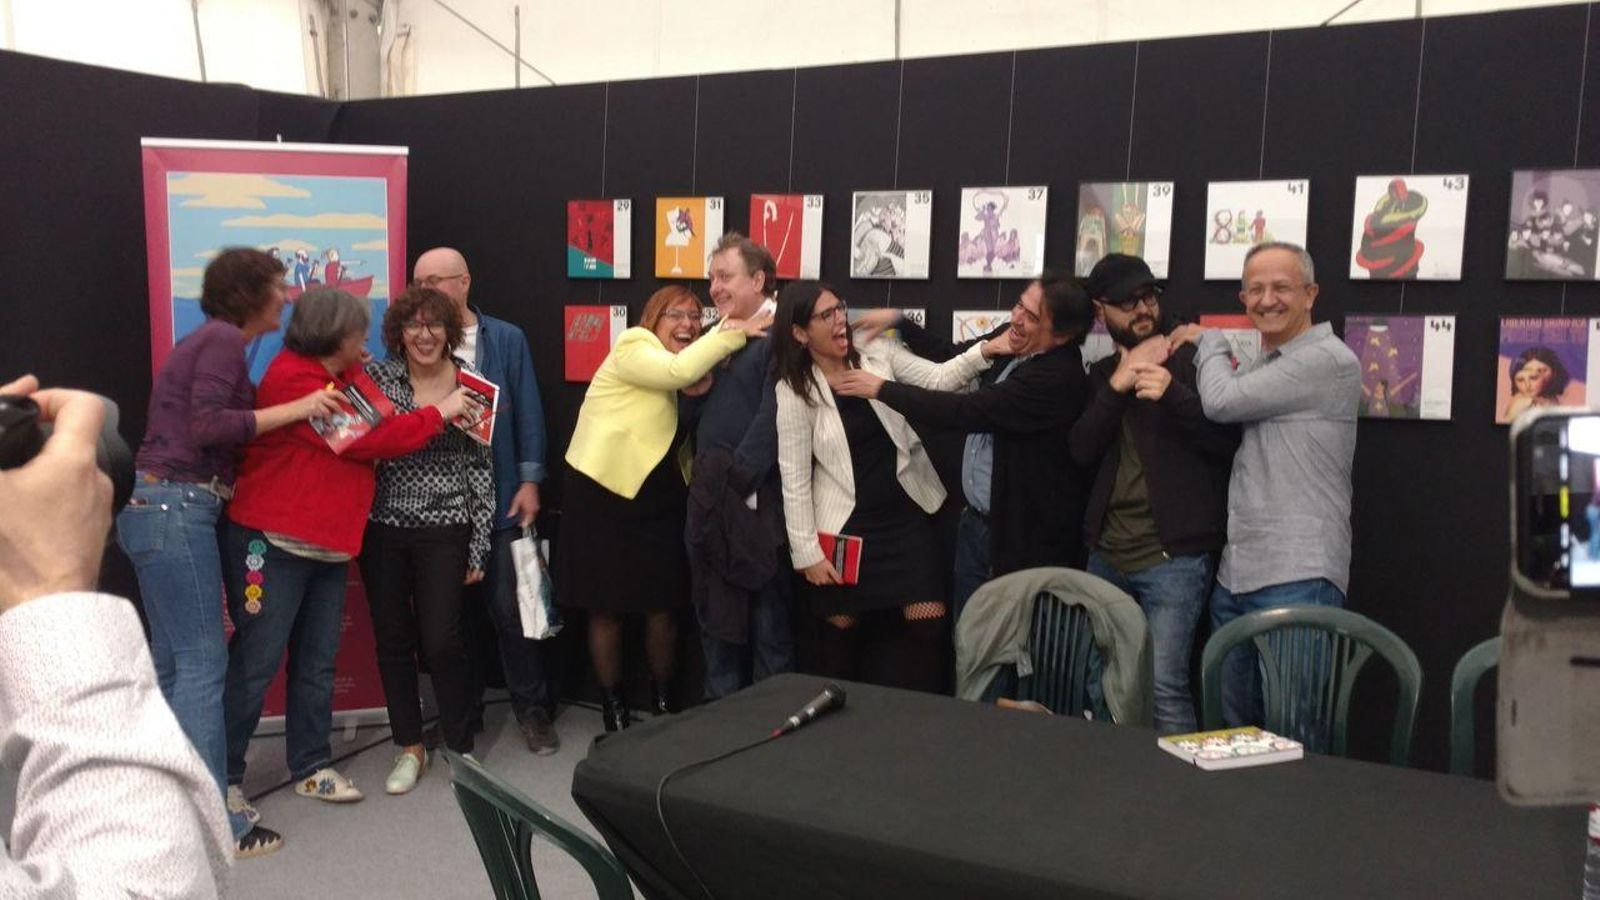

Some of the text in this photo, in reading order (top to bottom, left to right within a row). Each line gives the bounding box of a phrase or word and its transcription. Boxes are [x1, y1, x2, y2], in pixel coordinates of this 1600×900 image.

[1288, 182, 1304, 195] 41
[1443, 177, 1464, 190] 43
[1028, 187, 1043, 200] 37
[1152, 186, 1171, 197] 39
[806, 198, 821, 209] 33
[915, 193, 930, 204] 35
[617, 200, 631, 211] 29
[710, 199, 722, 210] 31
[613, 307, 626, 318] 30
[705, 310, 719, 320] 32
[1431, 319, 1452, 333] 44
